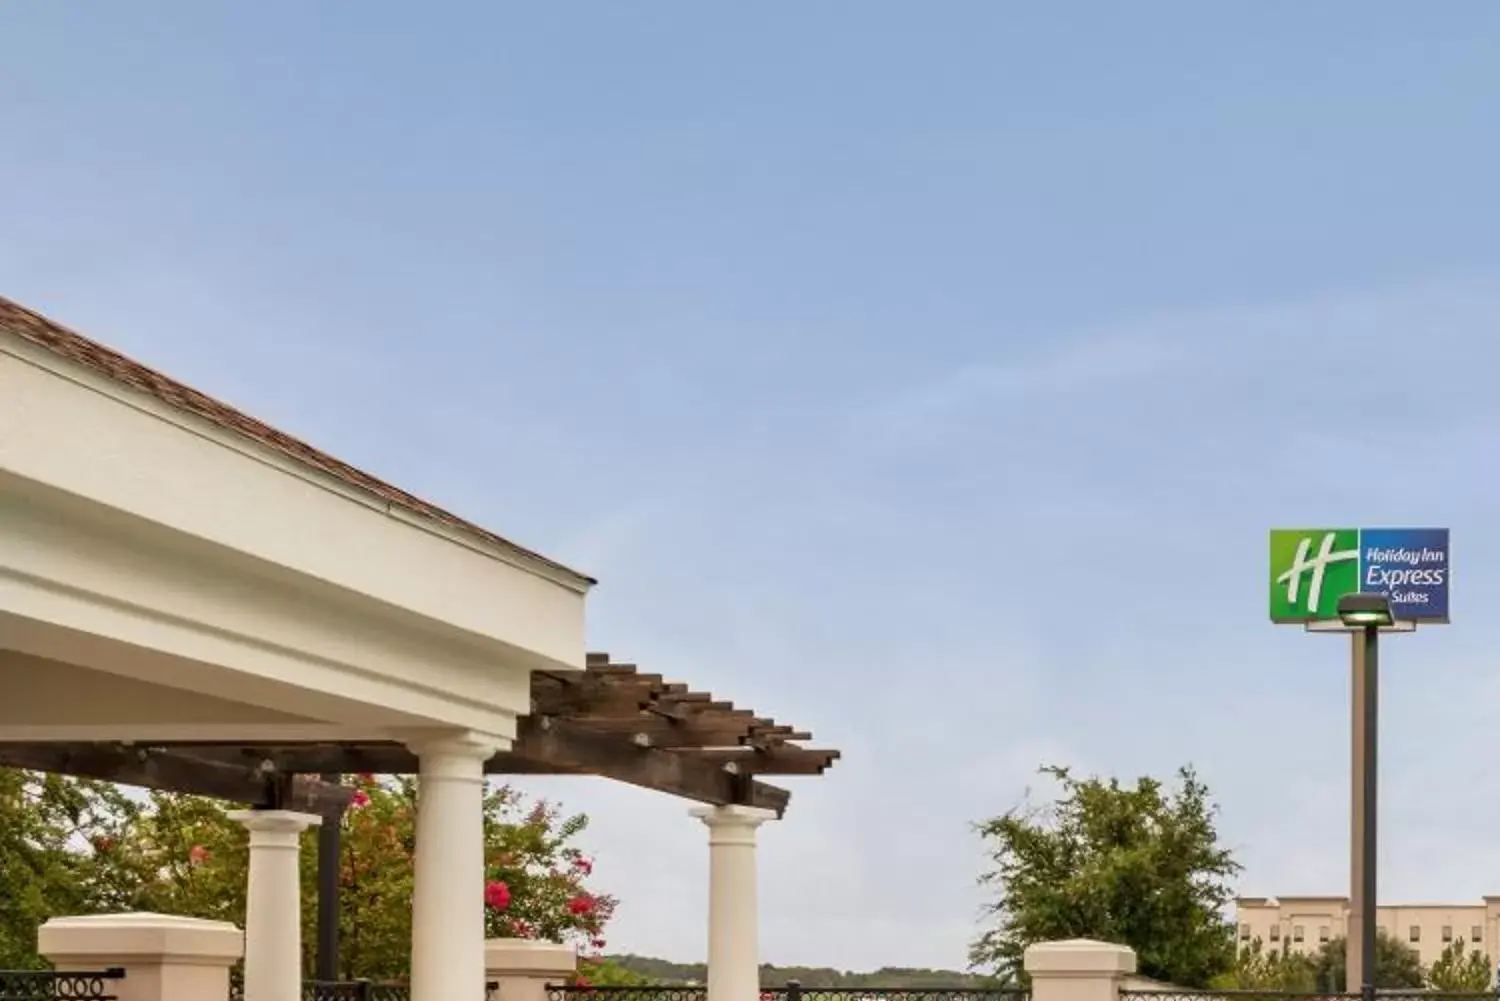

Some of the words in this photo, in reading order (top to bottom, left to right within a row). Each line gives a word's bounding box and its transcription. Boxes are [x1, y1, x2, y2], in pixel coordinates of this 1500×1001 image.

[1367, 548, 1420, 564] Holiday
[1421, 548, 1444, 562] Inn
[1367, 565, 1444, 588] Express
[1391, 591, 1429, 603] Suites
